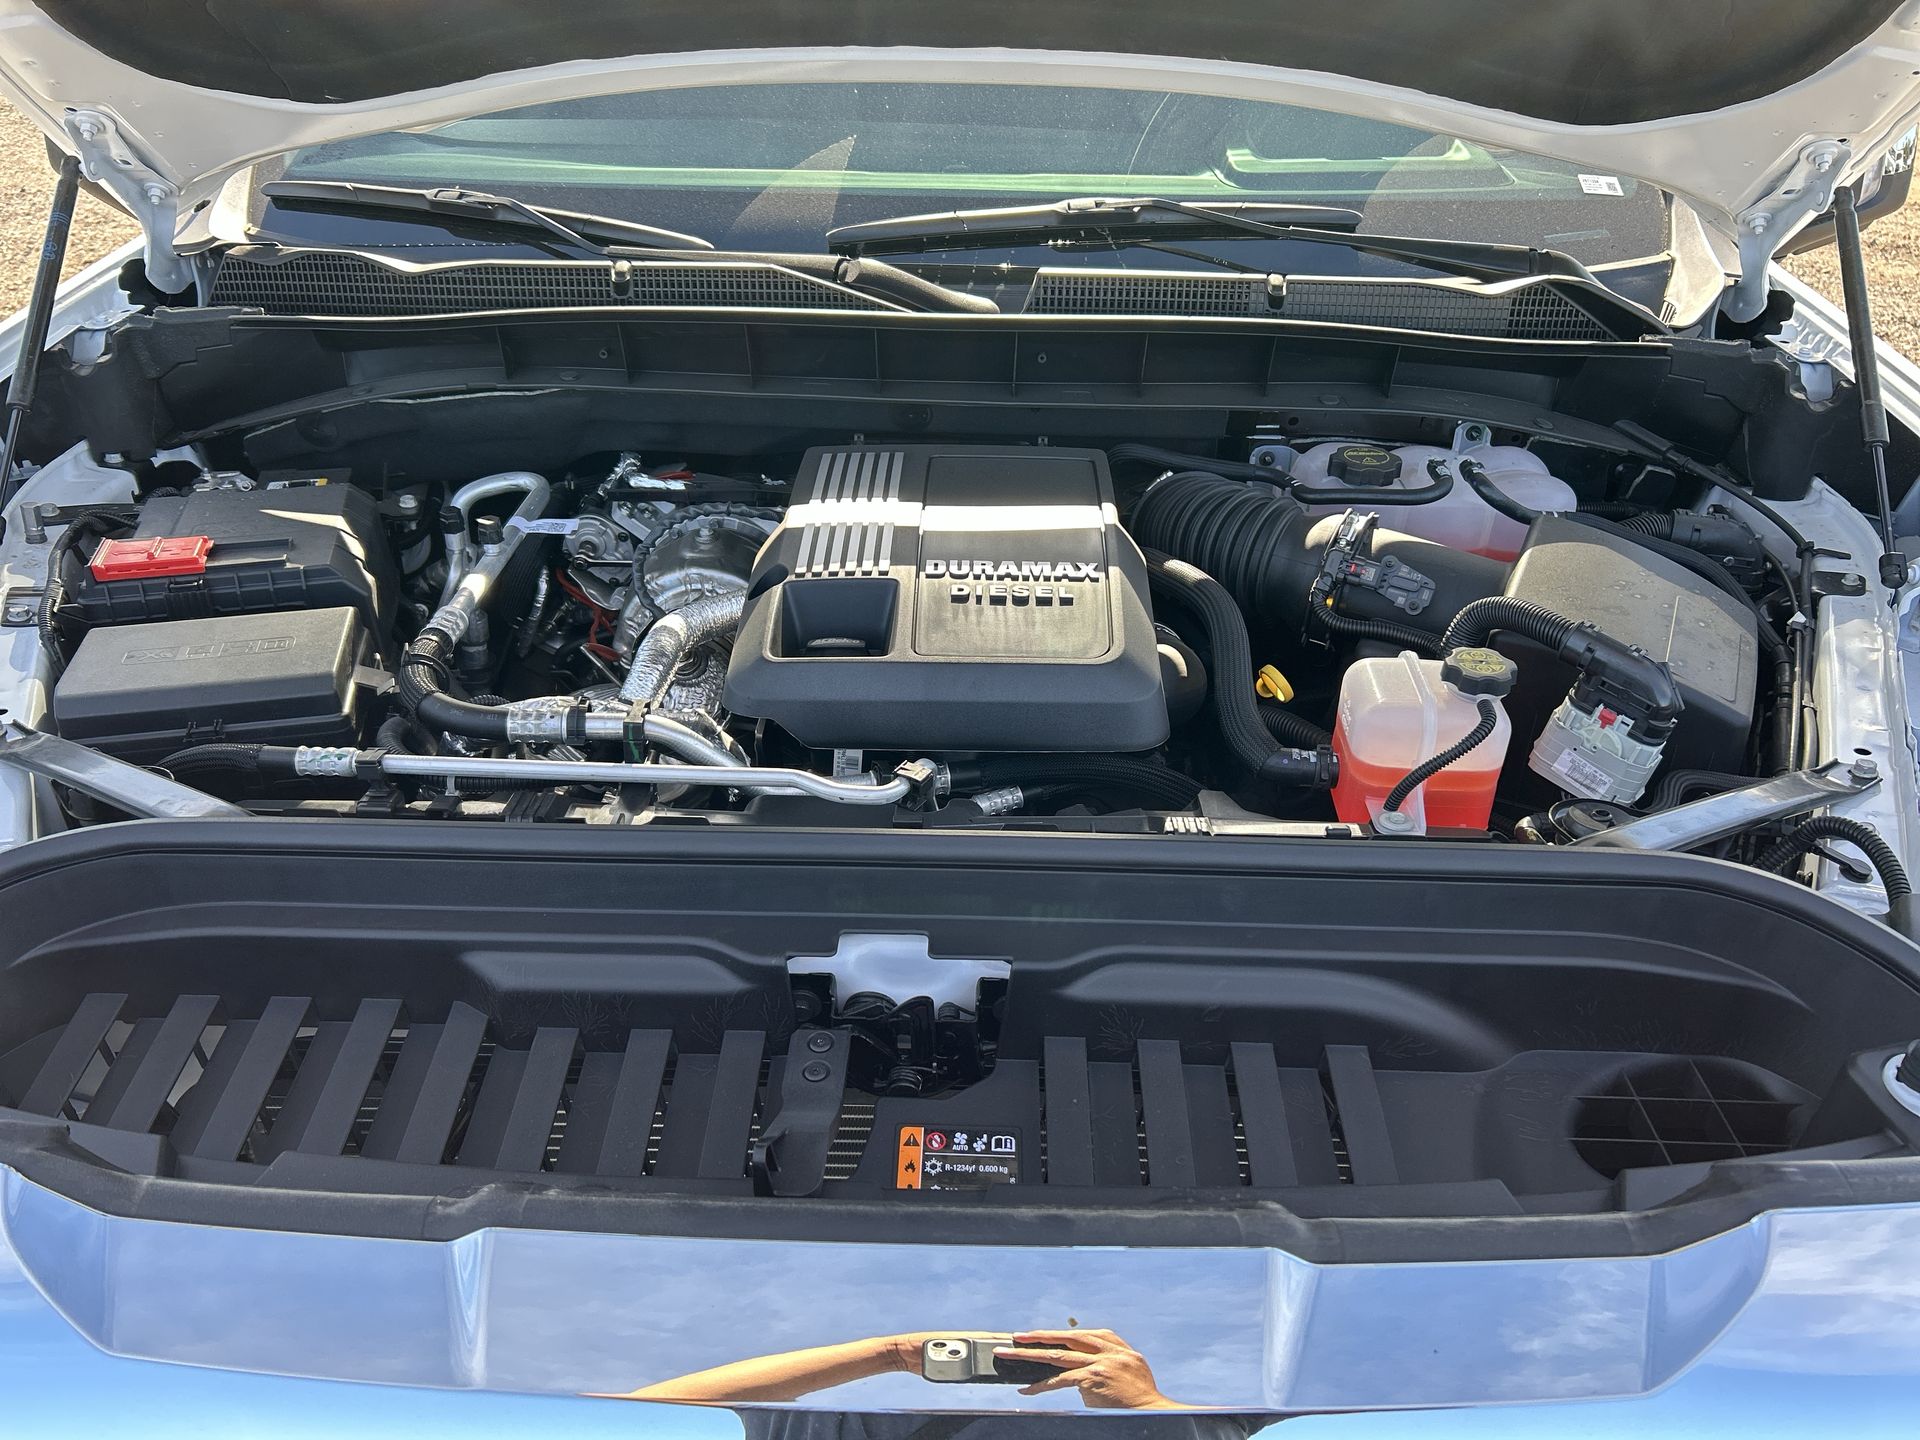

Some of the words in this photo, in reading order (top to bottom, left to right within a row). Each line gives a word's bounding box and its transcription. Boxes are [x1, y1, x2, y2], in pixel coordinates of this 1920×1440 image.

[925, 559, 1100, 582] DURAMAX
[950, 584, 1074, 605] DIESEL
[945, 1163, 976, 1173] R-1234yf
[978, 1164, 998, 1173] 0.600
[1000, 1165, 1008, 1174] kg
